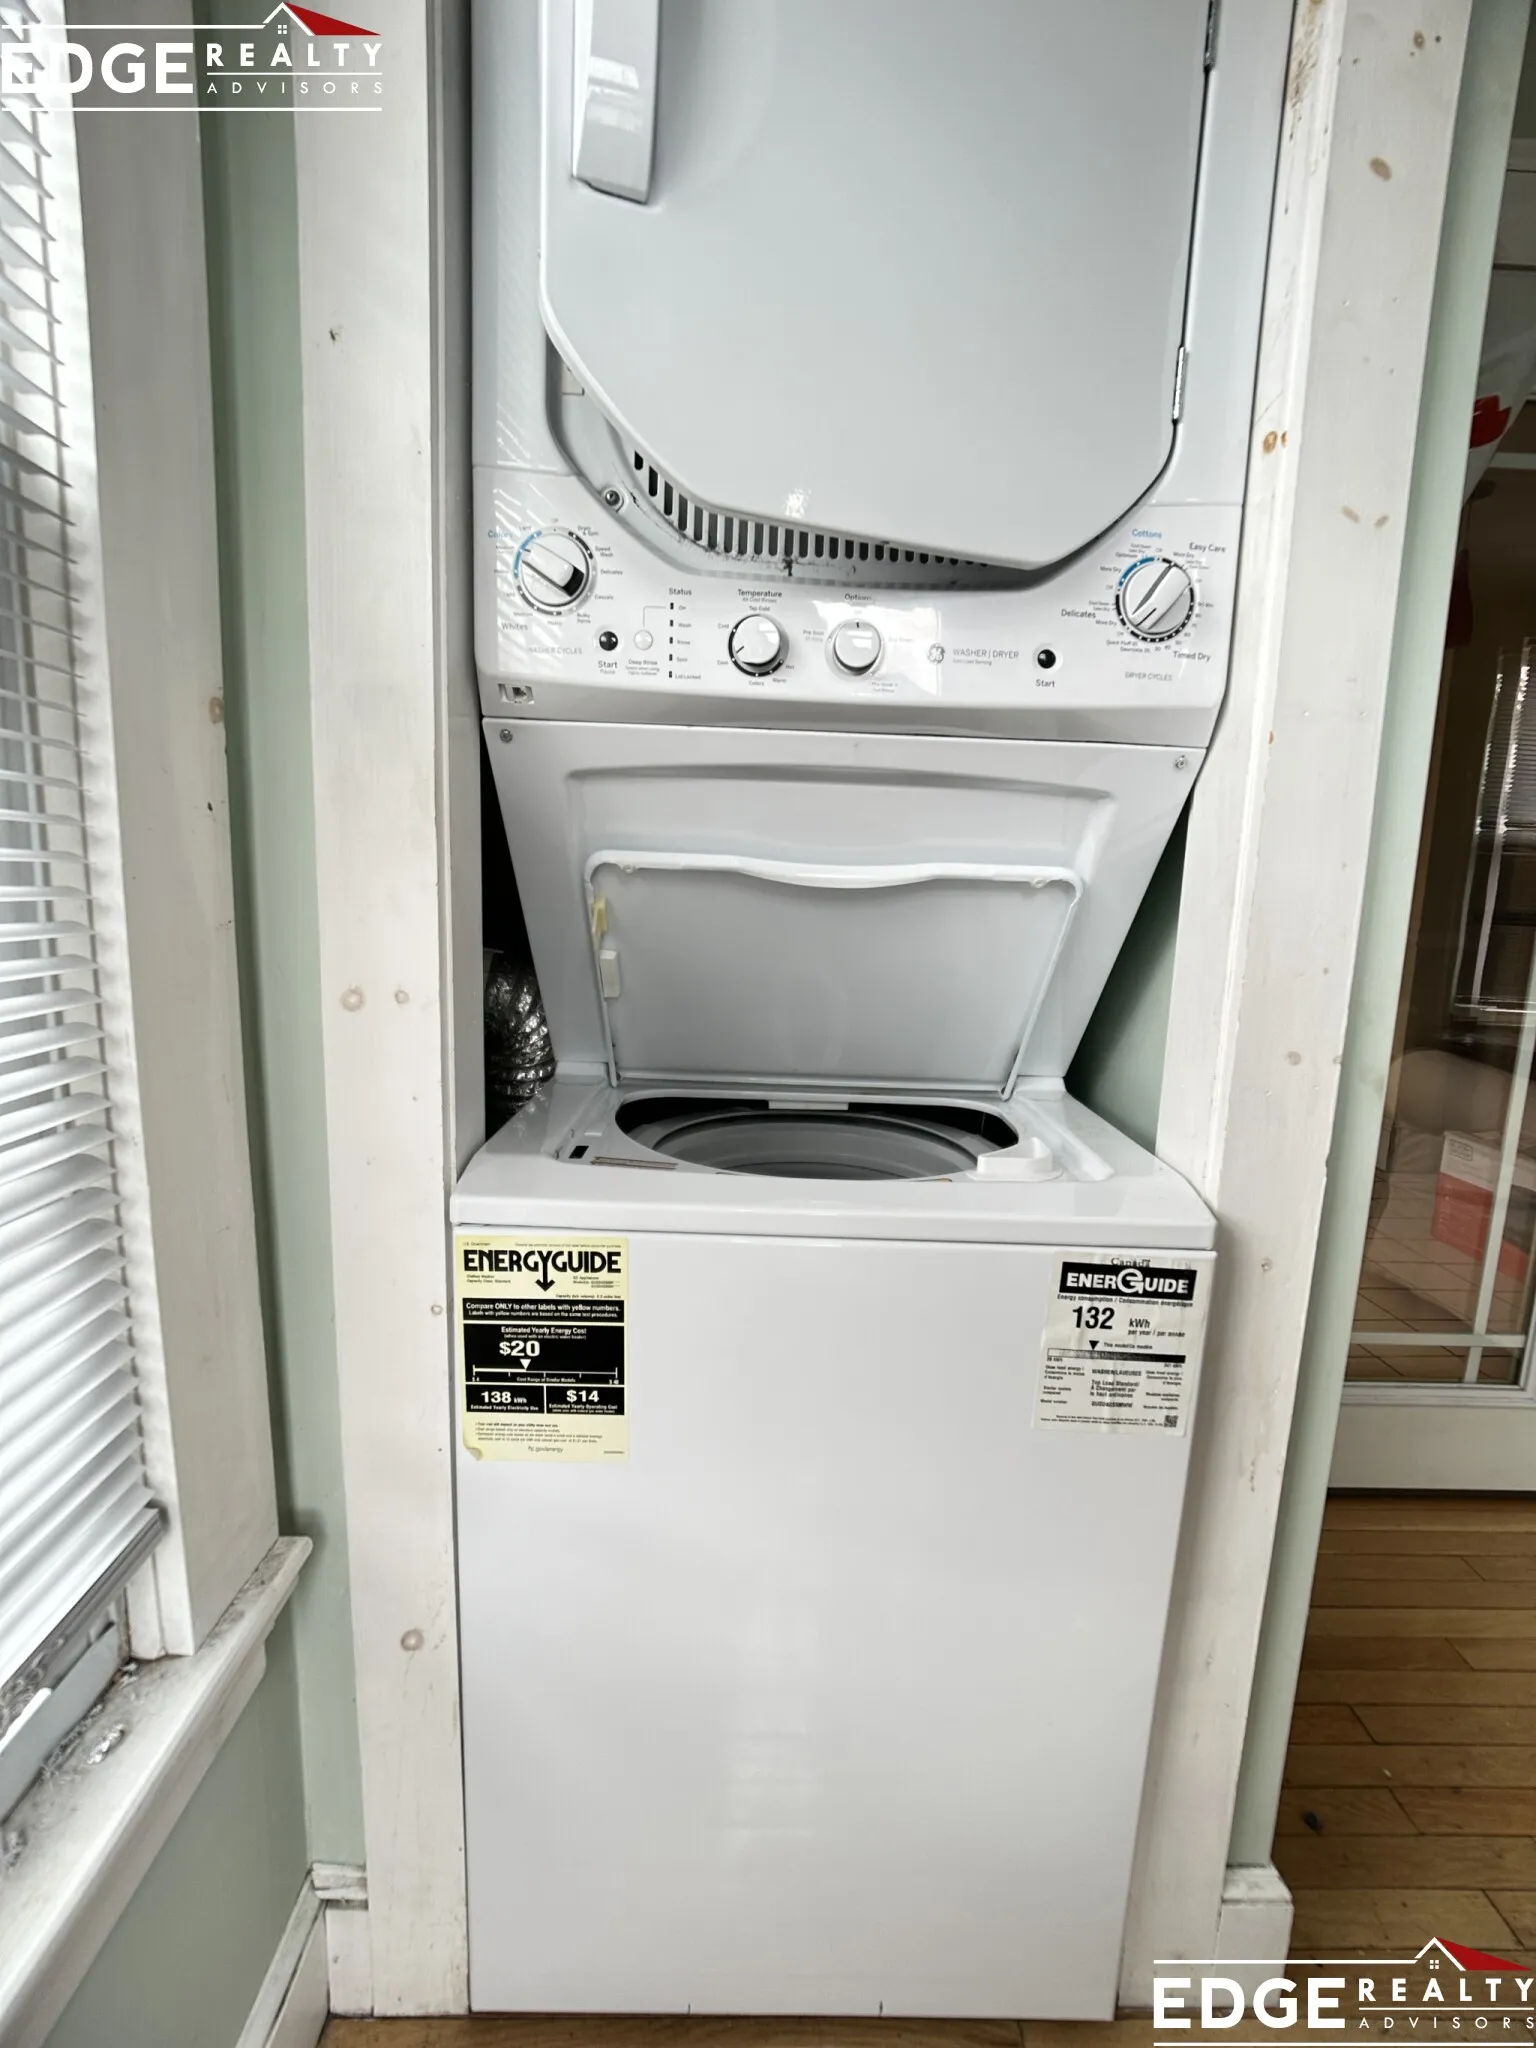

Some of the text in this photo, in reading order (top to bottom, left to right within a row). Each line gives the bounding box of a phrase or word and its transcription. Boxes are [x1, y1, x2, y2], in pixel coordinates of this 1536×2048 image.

[1132, 528, 1162, 539] Cottons
[1189, 542, 1226, 553] Easy Care
[668, 588, 692, 596] Status
[738, 589, 782, 598] Temperature
[1060, 608, 1096, 619] Delicates
[502, 622, 528, 631] Whites
[953, 648, 987, 658] WASHER
[992, 650, 1020, 660] DRYER
[1173, 650, 1211, 664] Timed Dry
[598, 660, 618, 669] Start
[1124, 671, 1172, 682] DRYER CYCLES
[1036, 678, 1056, 688] Start
[1066, 1269, 1190, 1294] ENERGUIDE
[1057, 1293, 1076, 1302] Energy
[466, 1302, 494, 1310] Compare
[495, 1302, 512, 1310] ONLY
[572, 1304, 591, 1312] yellow
[1072, 1305, 1151, 1330] 132 kWh
[531, 1326, 549, 1335] Yearly
[551, 1327, 572, 1336] Energy
[500, 1340, 540, 1357] $20
[480, 1390, 527, 1404] 138 kWh
[566, 1389, 599, 1403] $14
